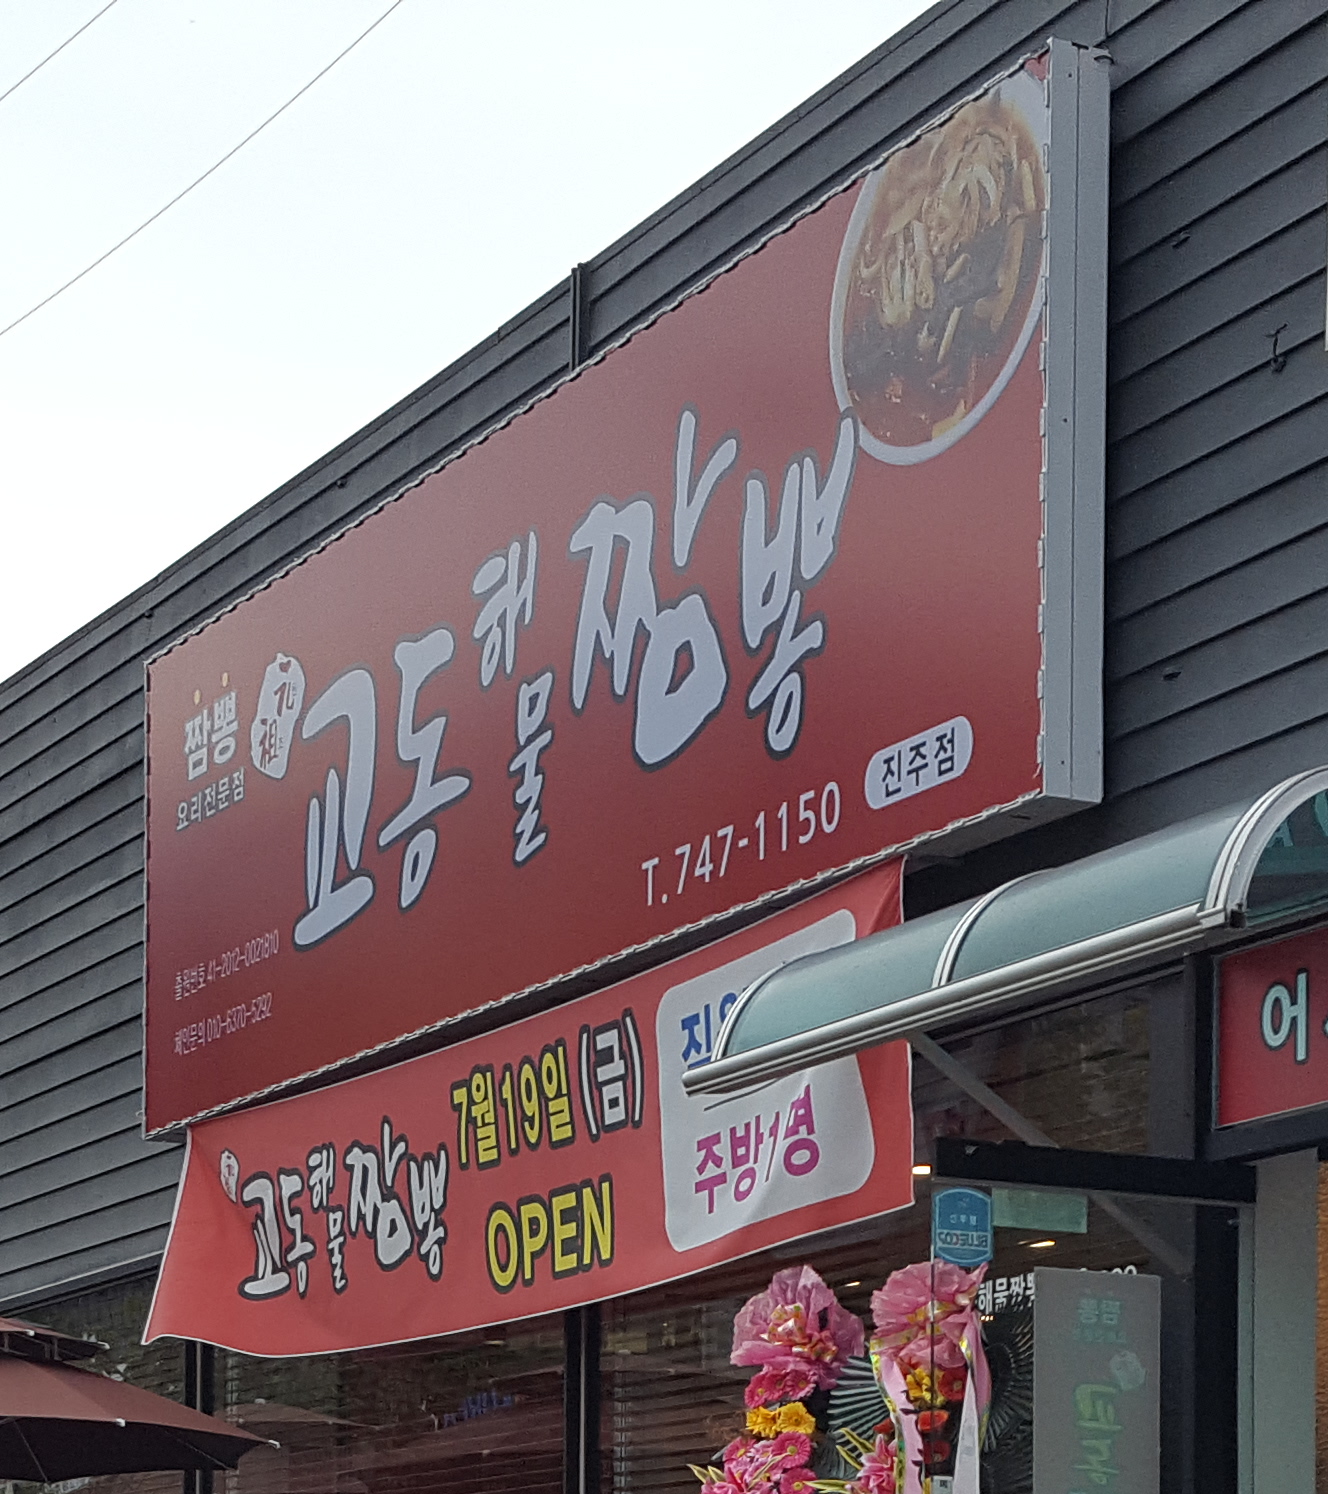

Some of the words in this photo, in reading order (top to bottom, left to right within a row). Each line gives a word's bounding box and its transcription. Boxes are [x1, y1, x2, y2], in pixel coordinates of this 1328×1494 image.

[177, 767, 244, 831] 요리전문점
[882, 727, 955, 798] 진주점
[642, 781, 841, 906] T.747-1150
[488, 1181, 612, 1287] OPEN
